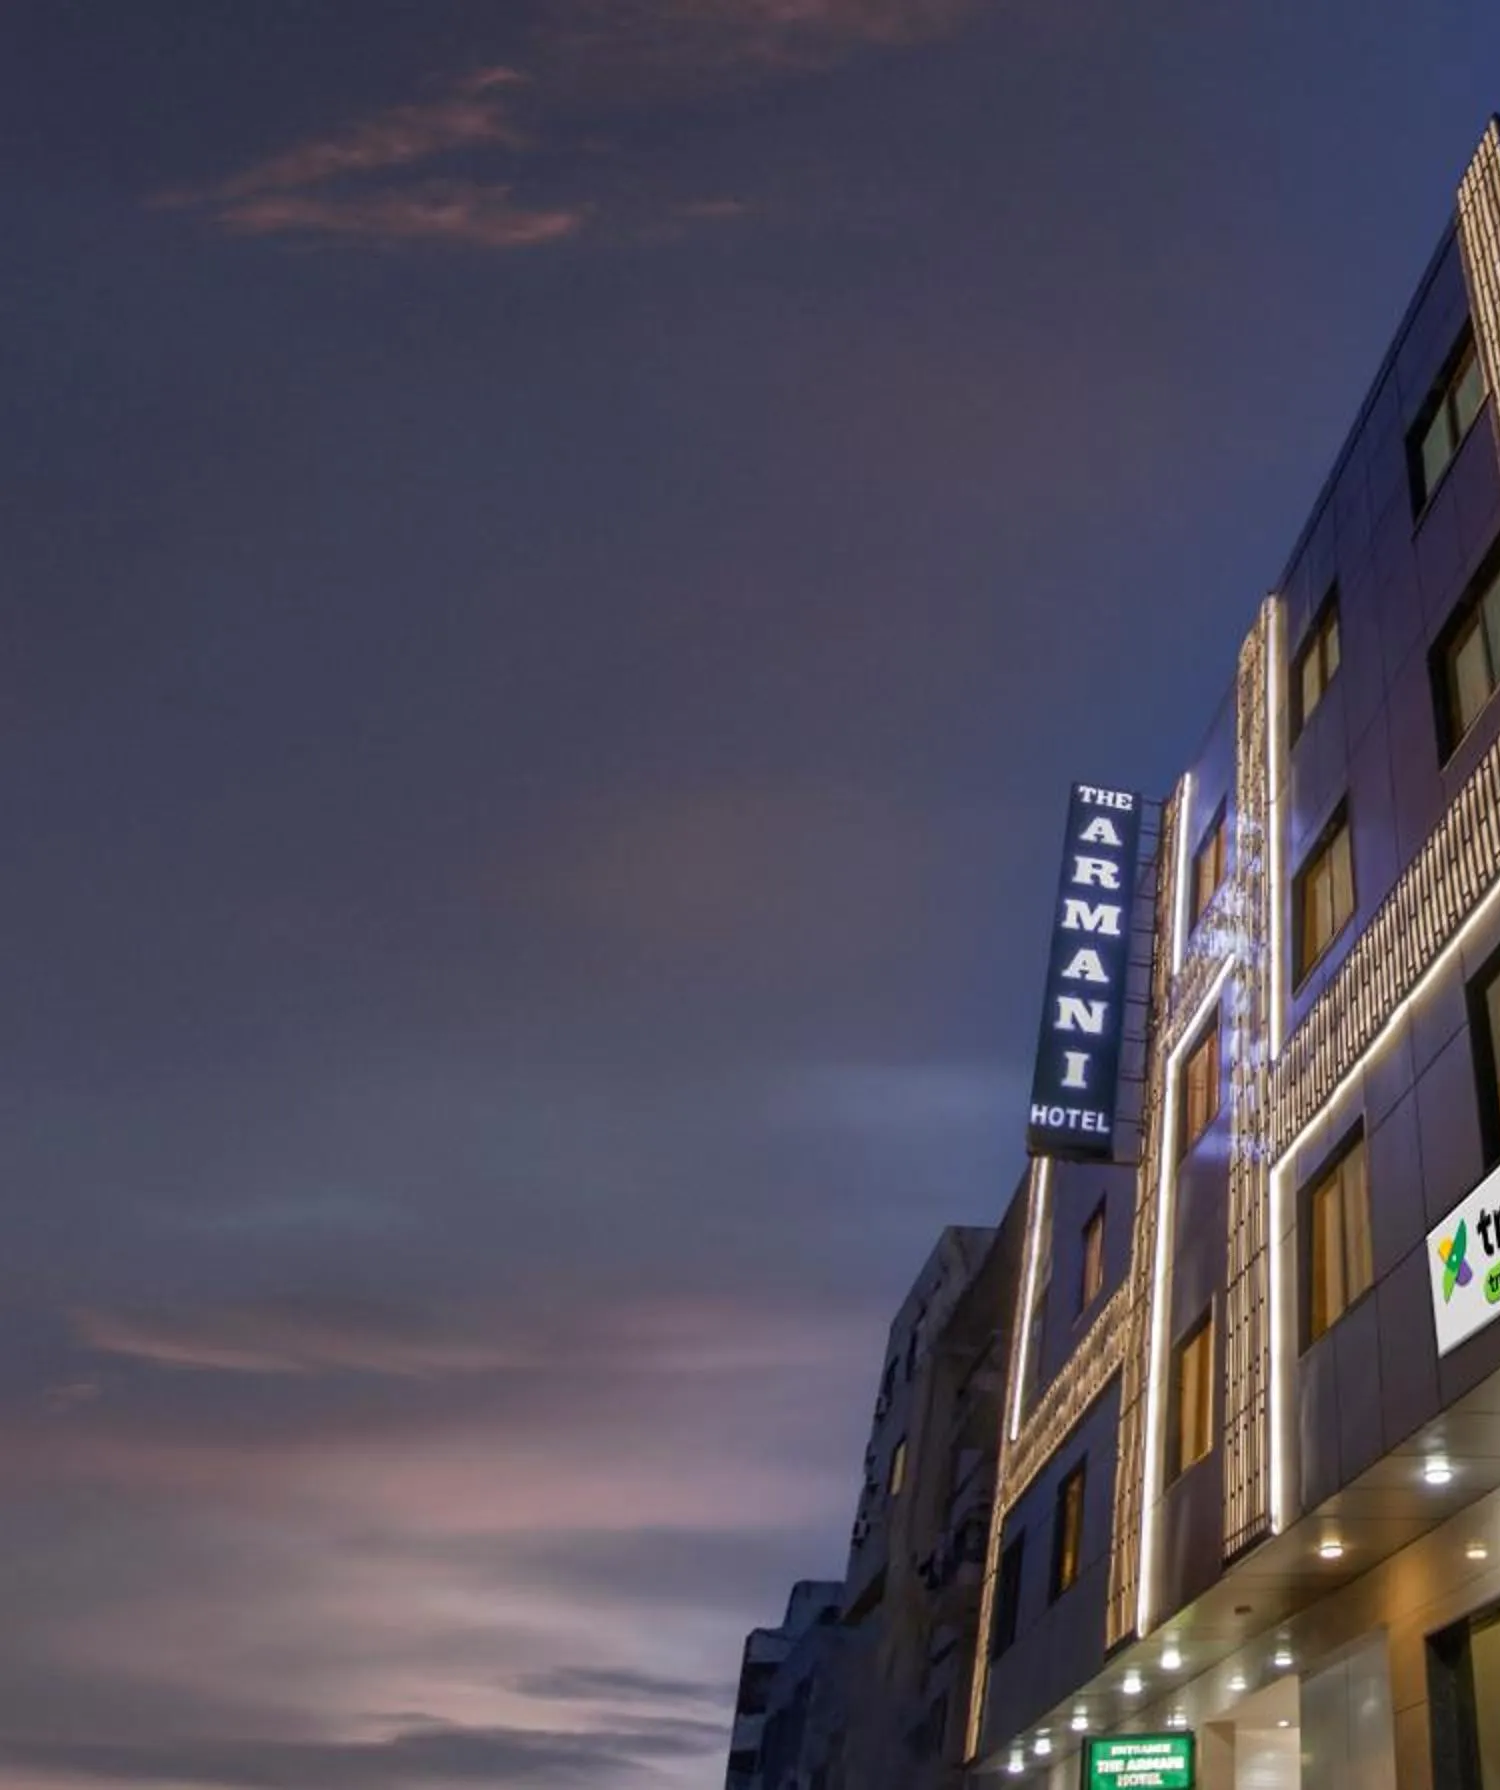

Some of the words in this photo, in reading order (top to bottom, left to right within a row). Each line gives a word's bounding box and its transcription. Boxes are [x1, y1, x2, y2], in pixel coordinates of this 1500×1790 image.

[1078, 784, 1133, 811] THE
[1053, 815, 1123, 1089] ARMANI
[1030, 1103, 1110, 1134] HOTEL
[1117, 1772, 1163, 1787] HOTEL
